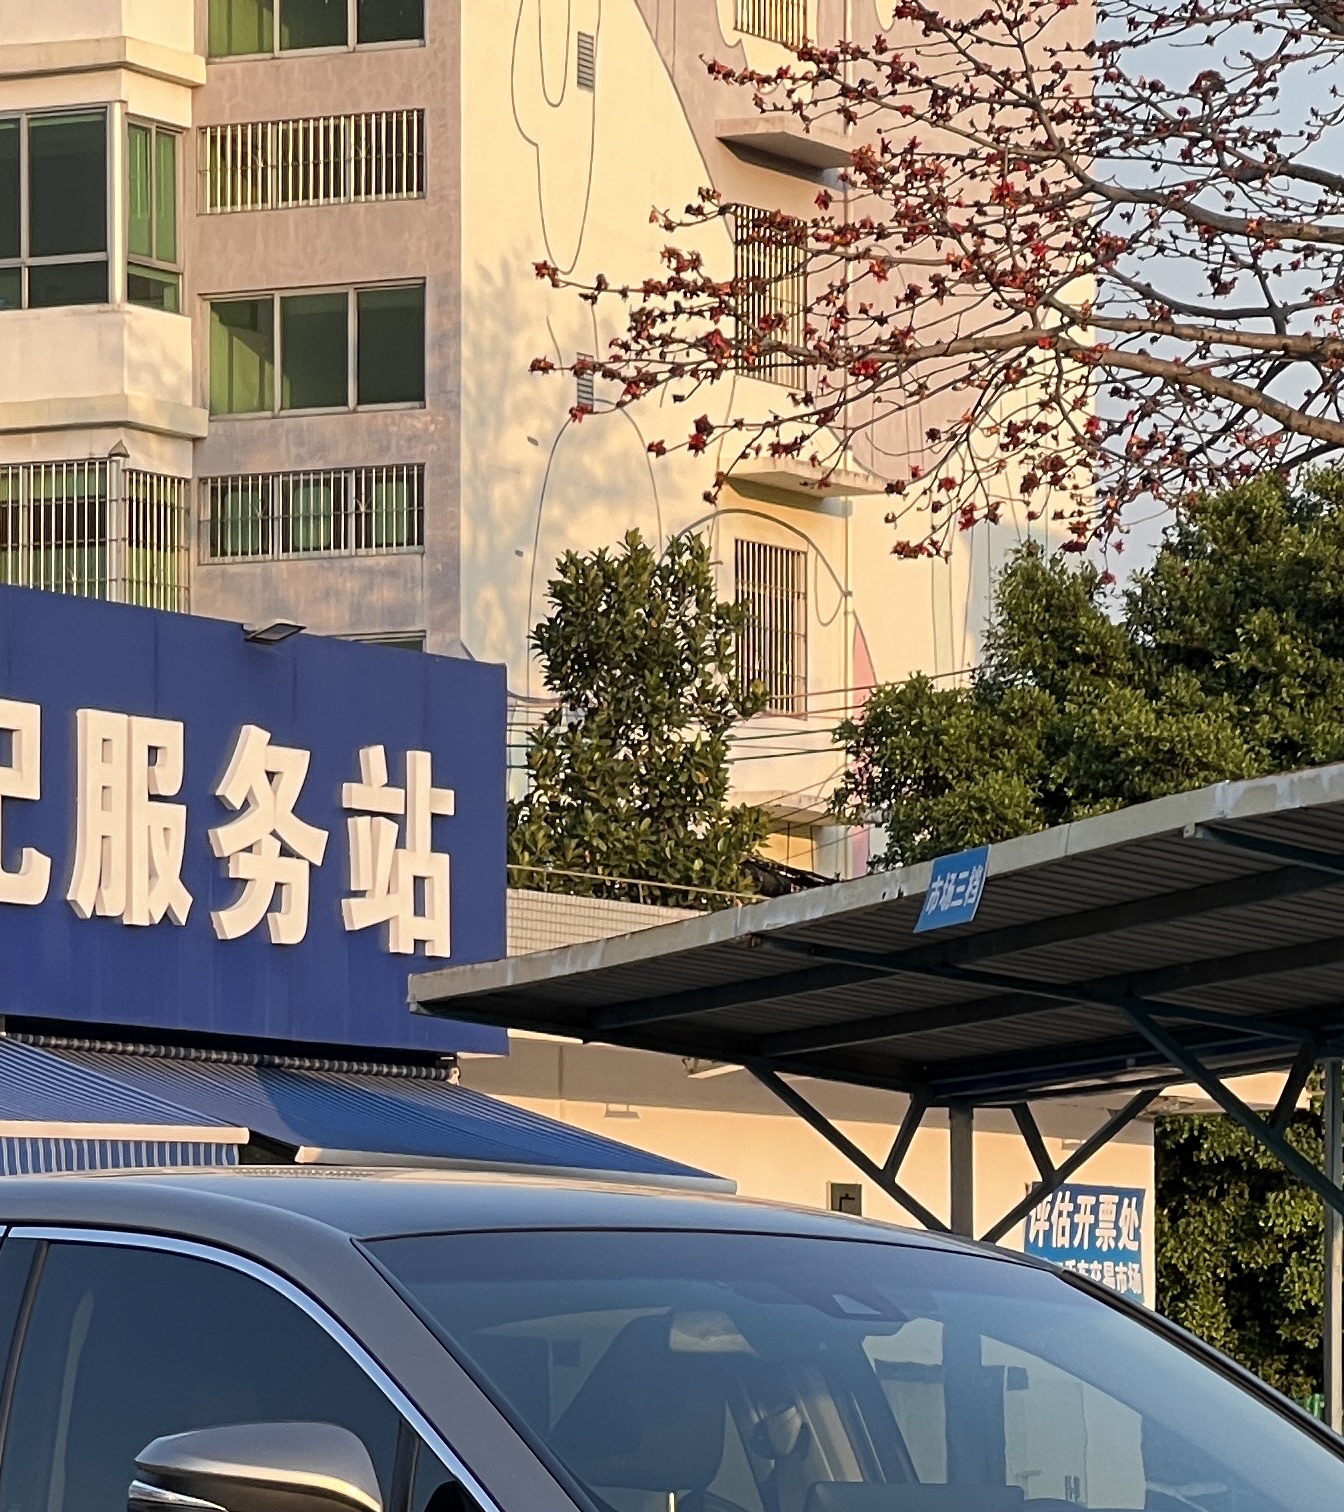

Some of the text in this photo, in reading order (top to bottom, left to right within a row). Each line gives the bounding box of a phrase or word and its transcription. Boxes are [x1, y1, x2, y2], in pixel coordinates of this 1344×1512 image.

[1029, 1190, 1139, 1251] 评估开票处
